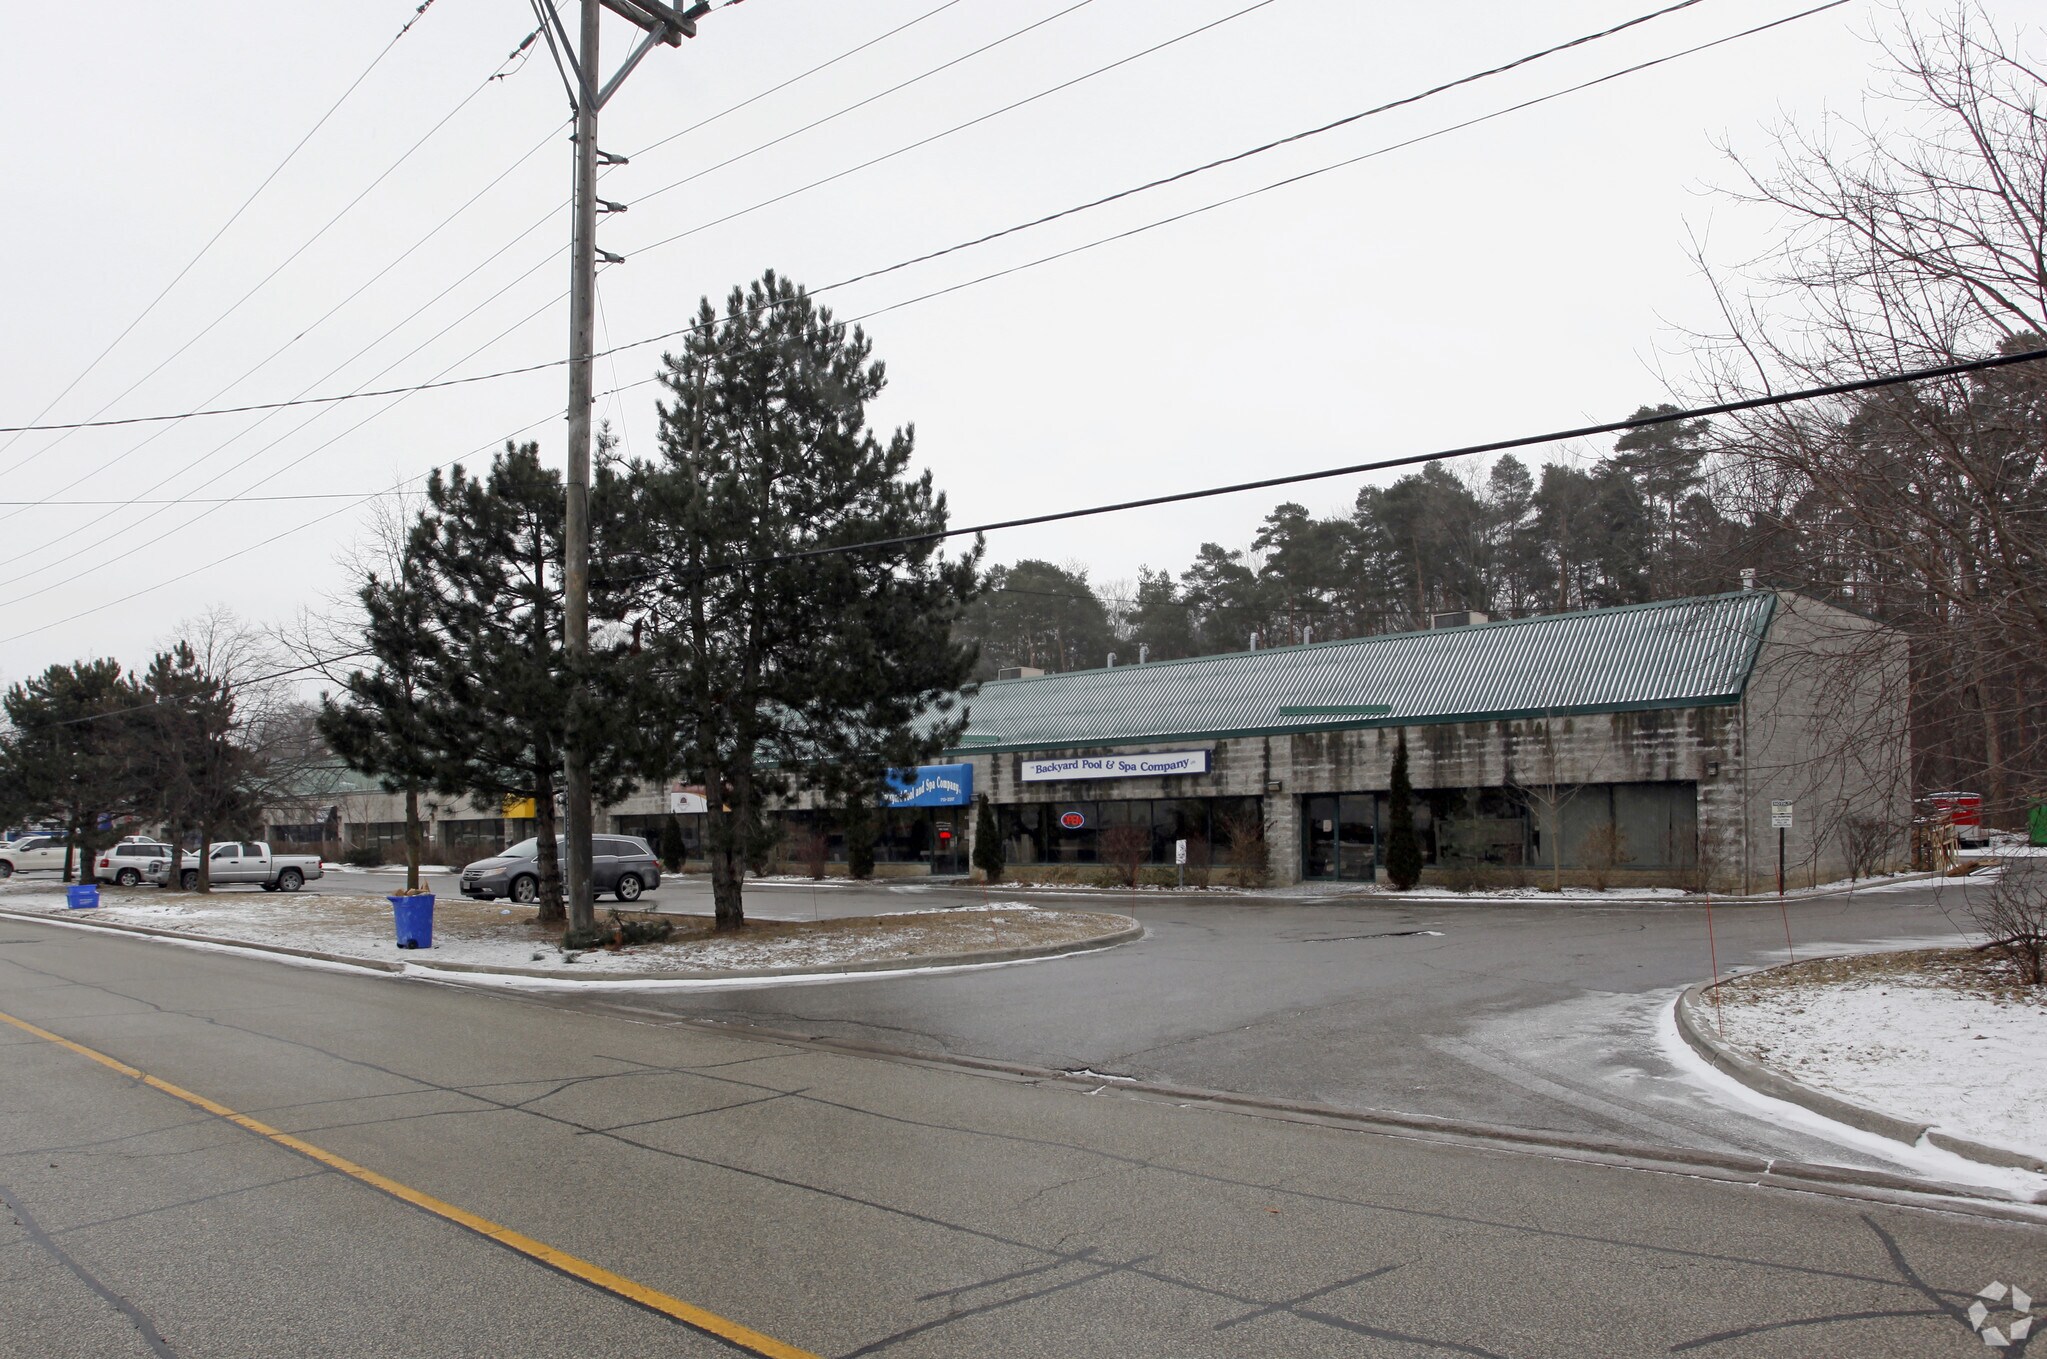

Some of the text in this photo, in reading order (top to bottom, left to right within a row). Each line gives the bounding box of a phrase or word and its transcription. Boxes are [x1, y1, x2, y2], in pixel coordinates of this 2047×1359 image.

[1035, 758, 1190, 774] Backyard Pool & Spa Company
[915, 780, 925, 797] and
[925, 778, 936, 793] Spa
[936, 776, 960, 795] Company
[1063, 814, 1082, 826] OPEN
